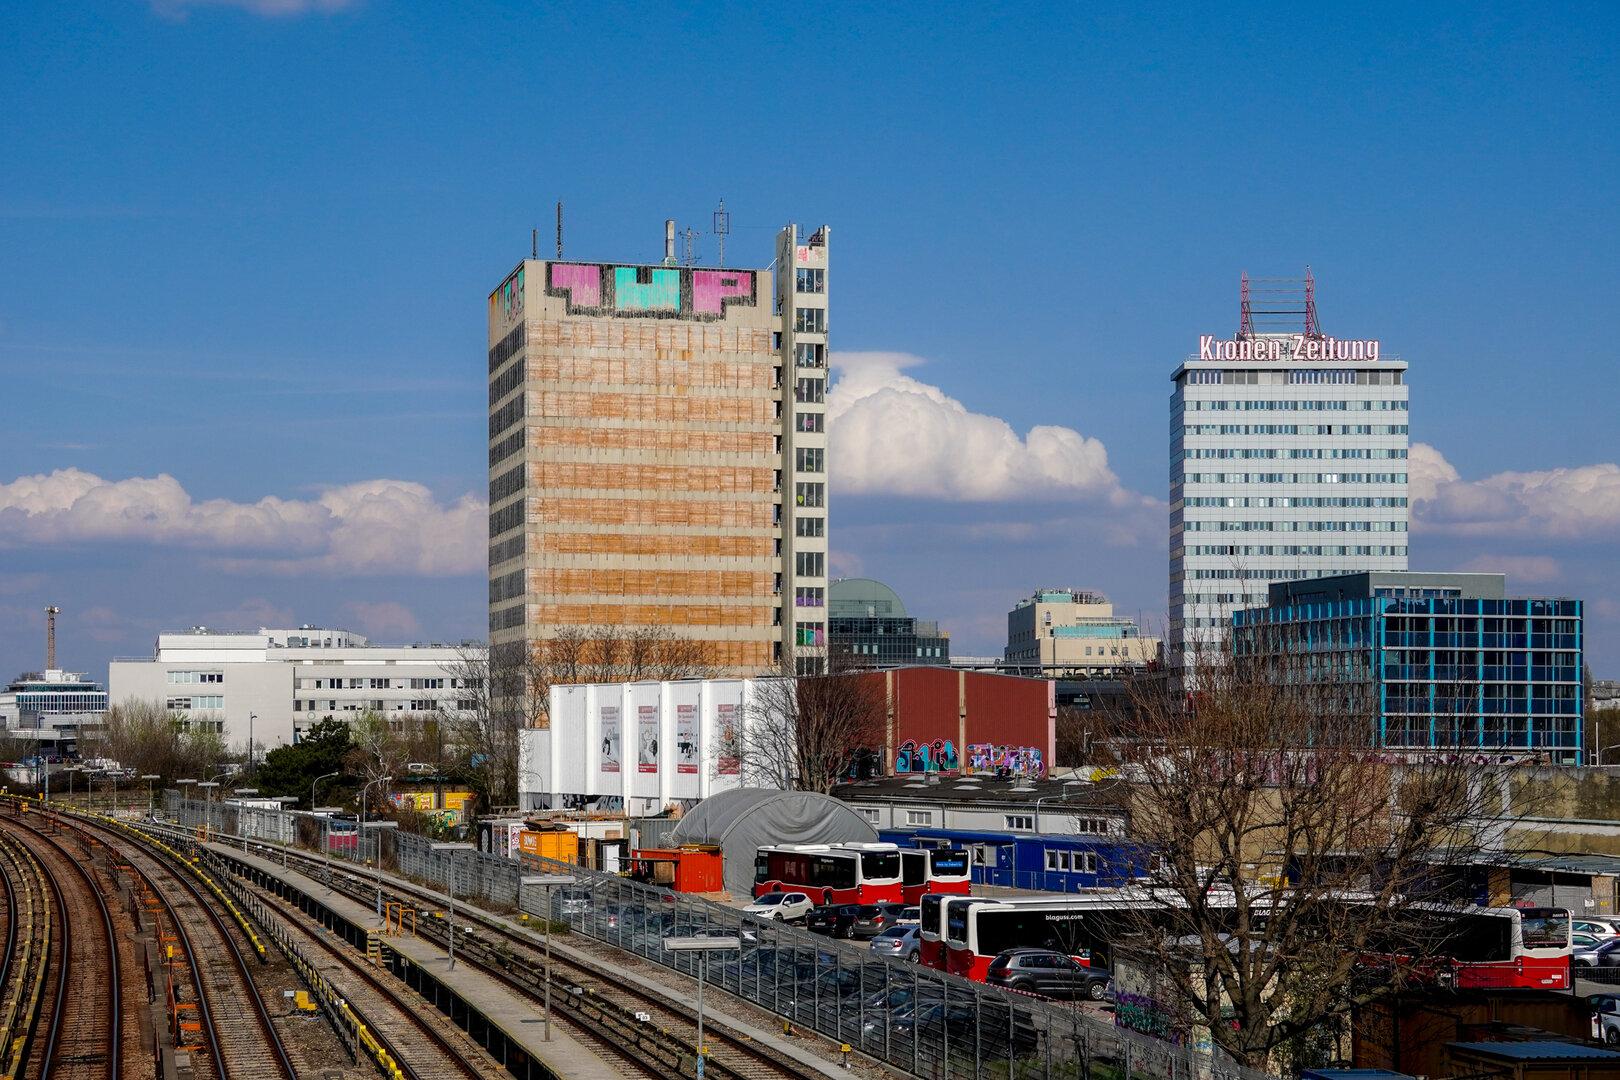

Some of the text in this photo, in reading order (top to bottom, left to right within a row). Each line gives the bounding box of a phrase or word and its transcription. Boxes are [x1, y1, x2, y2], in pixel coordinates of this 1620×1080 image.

[1199, 334, 1380, 362] Kronen Zeitung
[1045, 914, 1084, 922] blaguss.com
